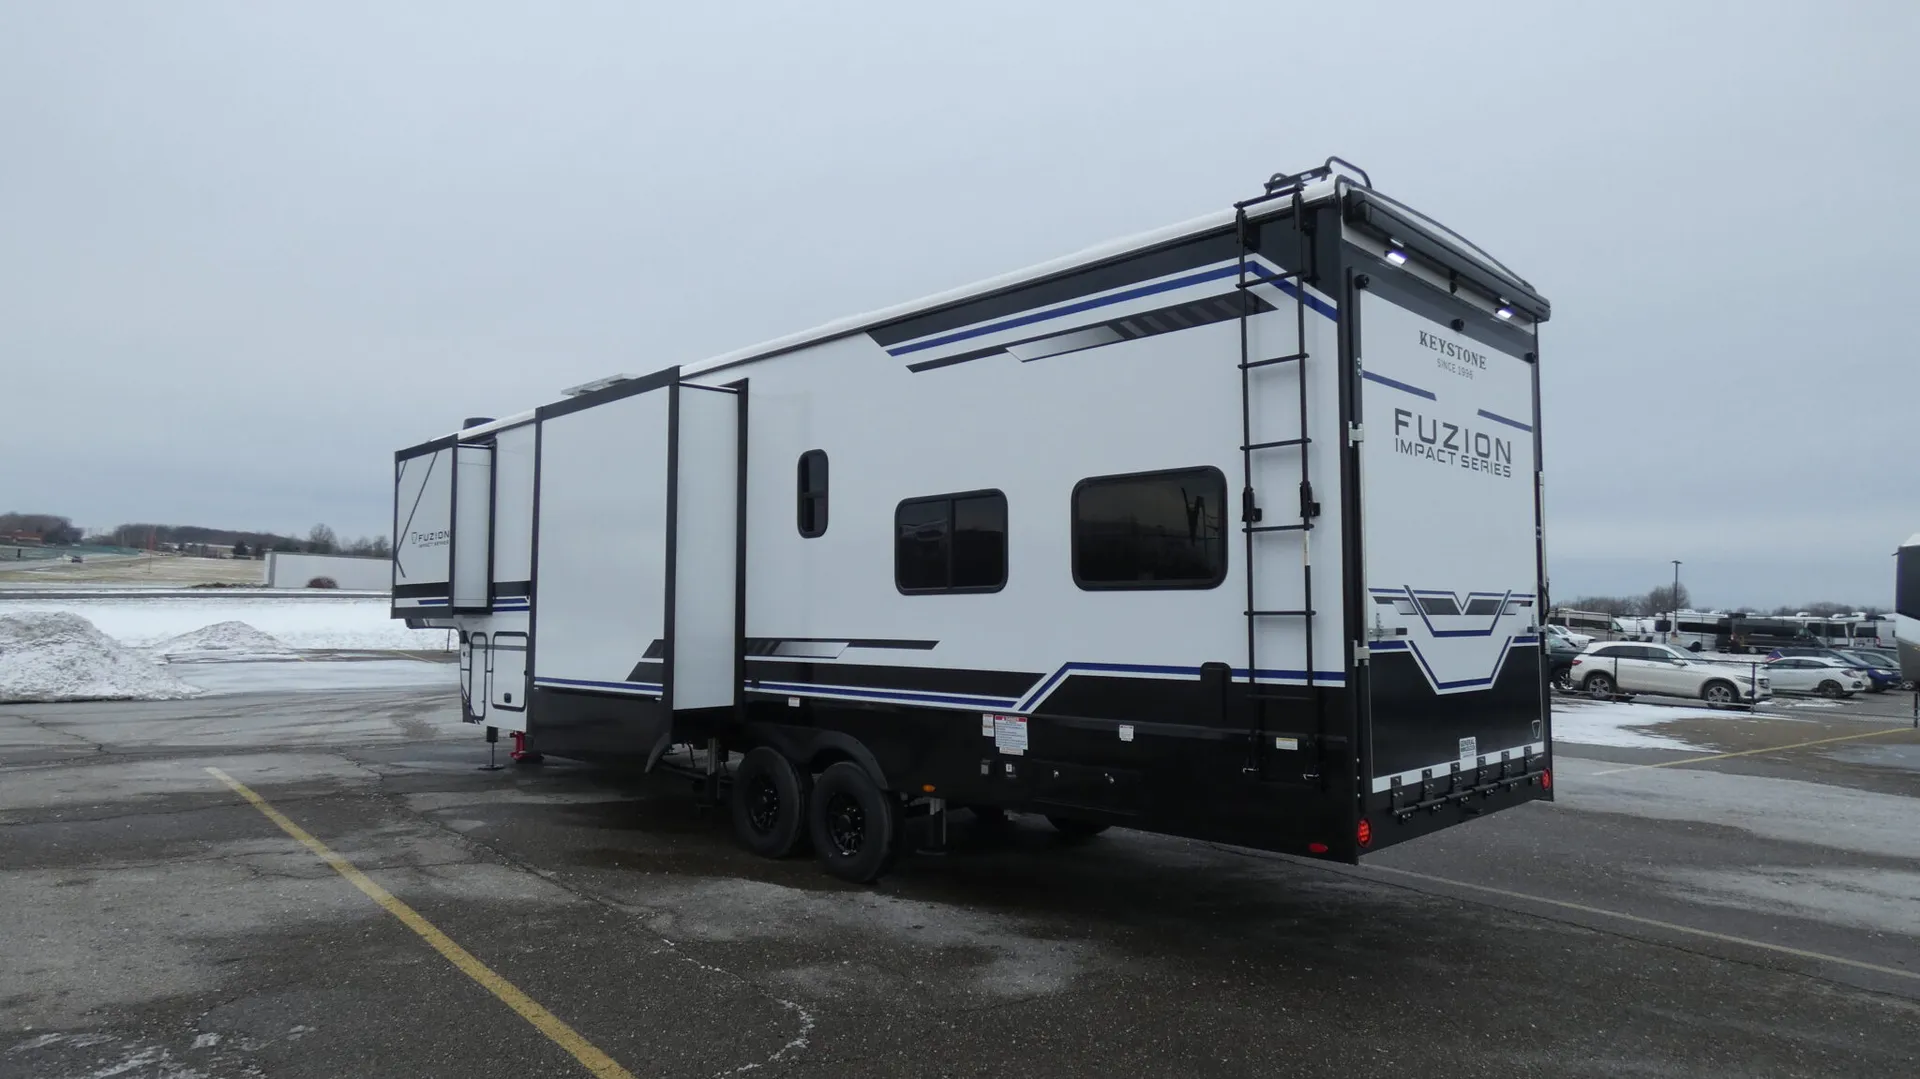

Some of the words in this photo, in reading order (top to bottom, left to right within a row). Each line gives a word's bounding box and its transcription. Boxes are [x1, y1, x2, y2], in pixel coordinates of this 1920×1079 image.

[1419, 330, 1487, 370] KEYSTONE
[1437, 358, 1456, 374] SINCE
[1395, 408, 1511, 464] FUZION
[1395, 438, 1456, 465] IMPACT
[1461, 456, 1511, 478] SERIES
[419, 530, 450, 541] FUZION
